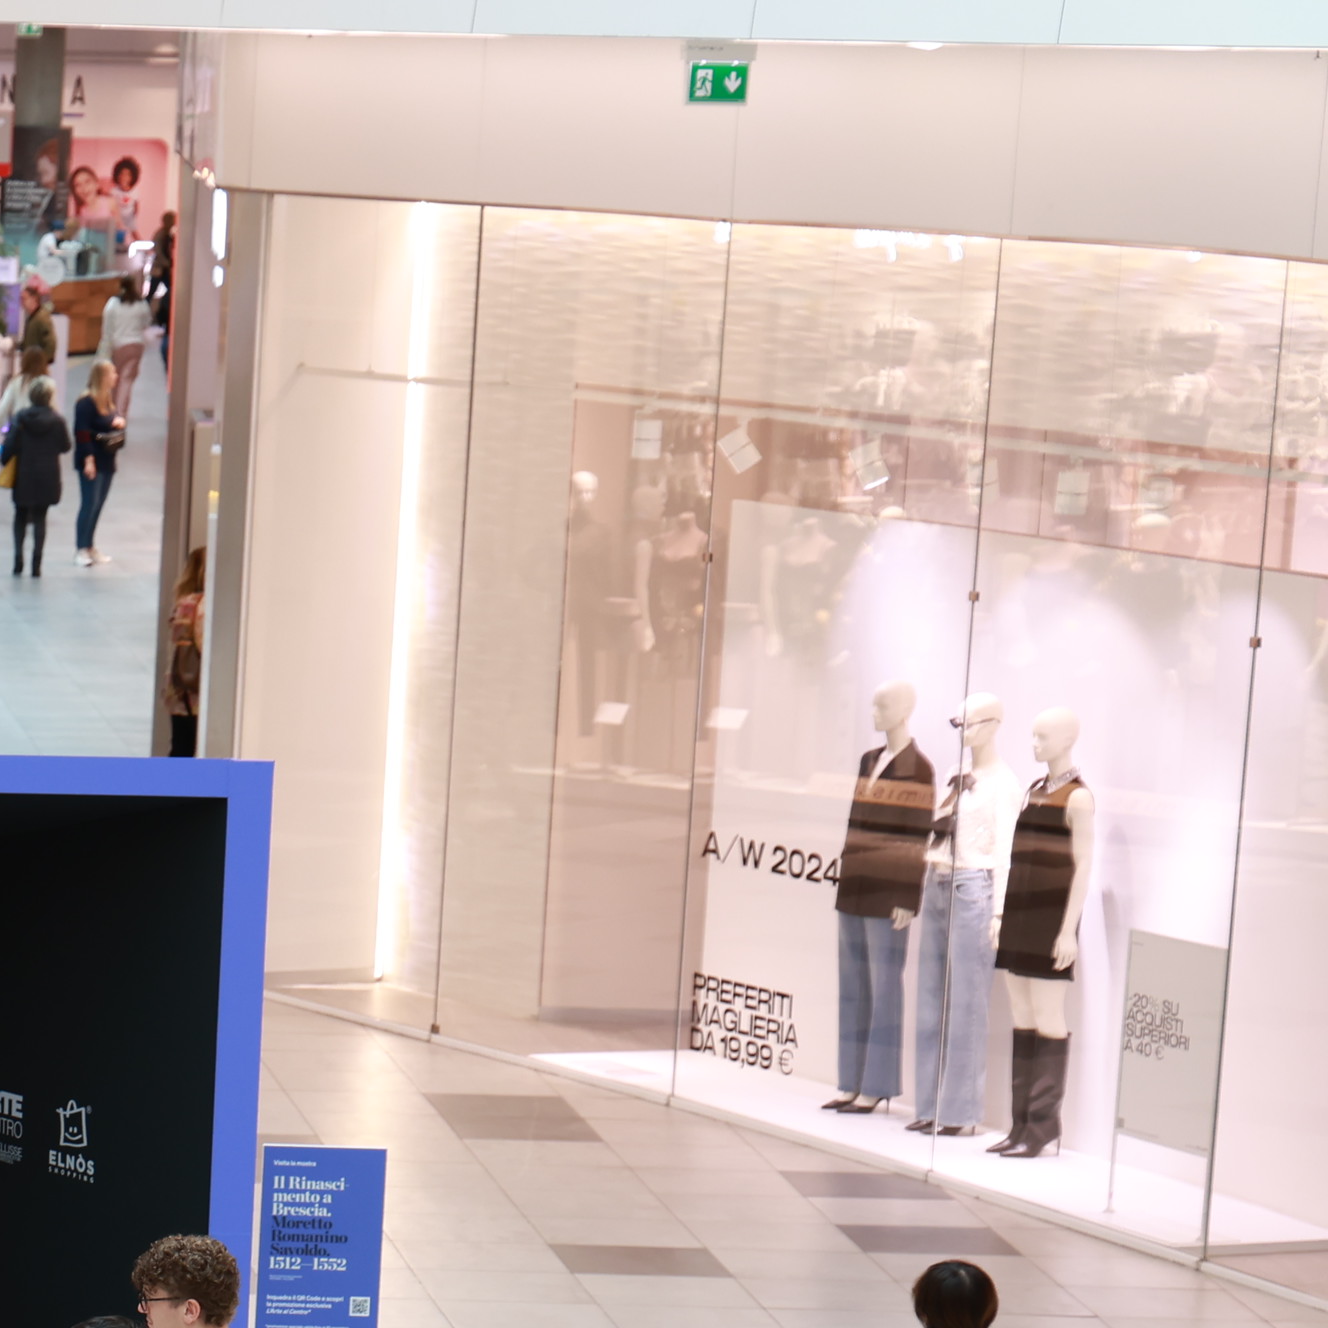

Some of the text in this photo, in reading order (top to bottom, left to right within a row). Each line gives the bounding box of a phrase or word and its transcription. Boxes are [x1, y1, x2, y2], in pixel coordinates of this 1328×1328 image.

[702, 831, 840, 886] A/W 2024
[693, 972, 793, 1019] PREFERITI
[1163, 1000, 1180, 1017] SU
[691, 999, 798, 1048] MAGLIERIA
[1126, 1009, 1184, 1034] ACQUISTI
[1125, 1024, 1190, 1050] SUPERIORI
[690, 1026, 794, 1075] DA 19,99 €
[1124, 1038, 1134, 1053] A
[1137, 1040, 1153, 1057] 40
[49, 1149, 94, 1175] ELNÒS
[48, 1166, 94, 1183] SHOPPING
[273, 1175, 350, 1191] Il Rinasci-
[273, 1191, 332, 1203] mento a
[272, 1203, 332, 1217] Brescia.
[272, 1216, 333, 1230] Moretto
[271, 1229, 348, 1244] Romanino
[270, 1243, 330, 1256] Savoldo.
